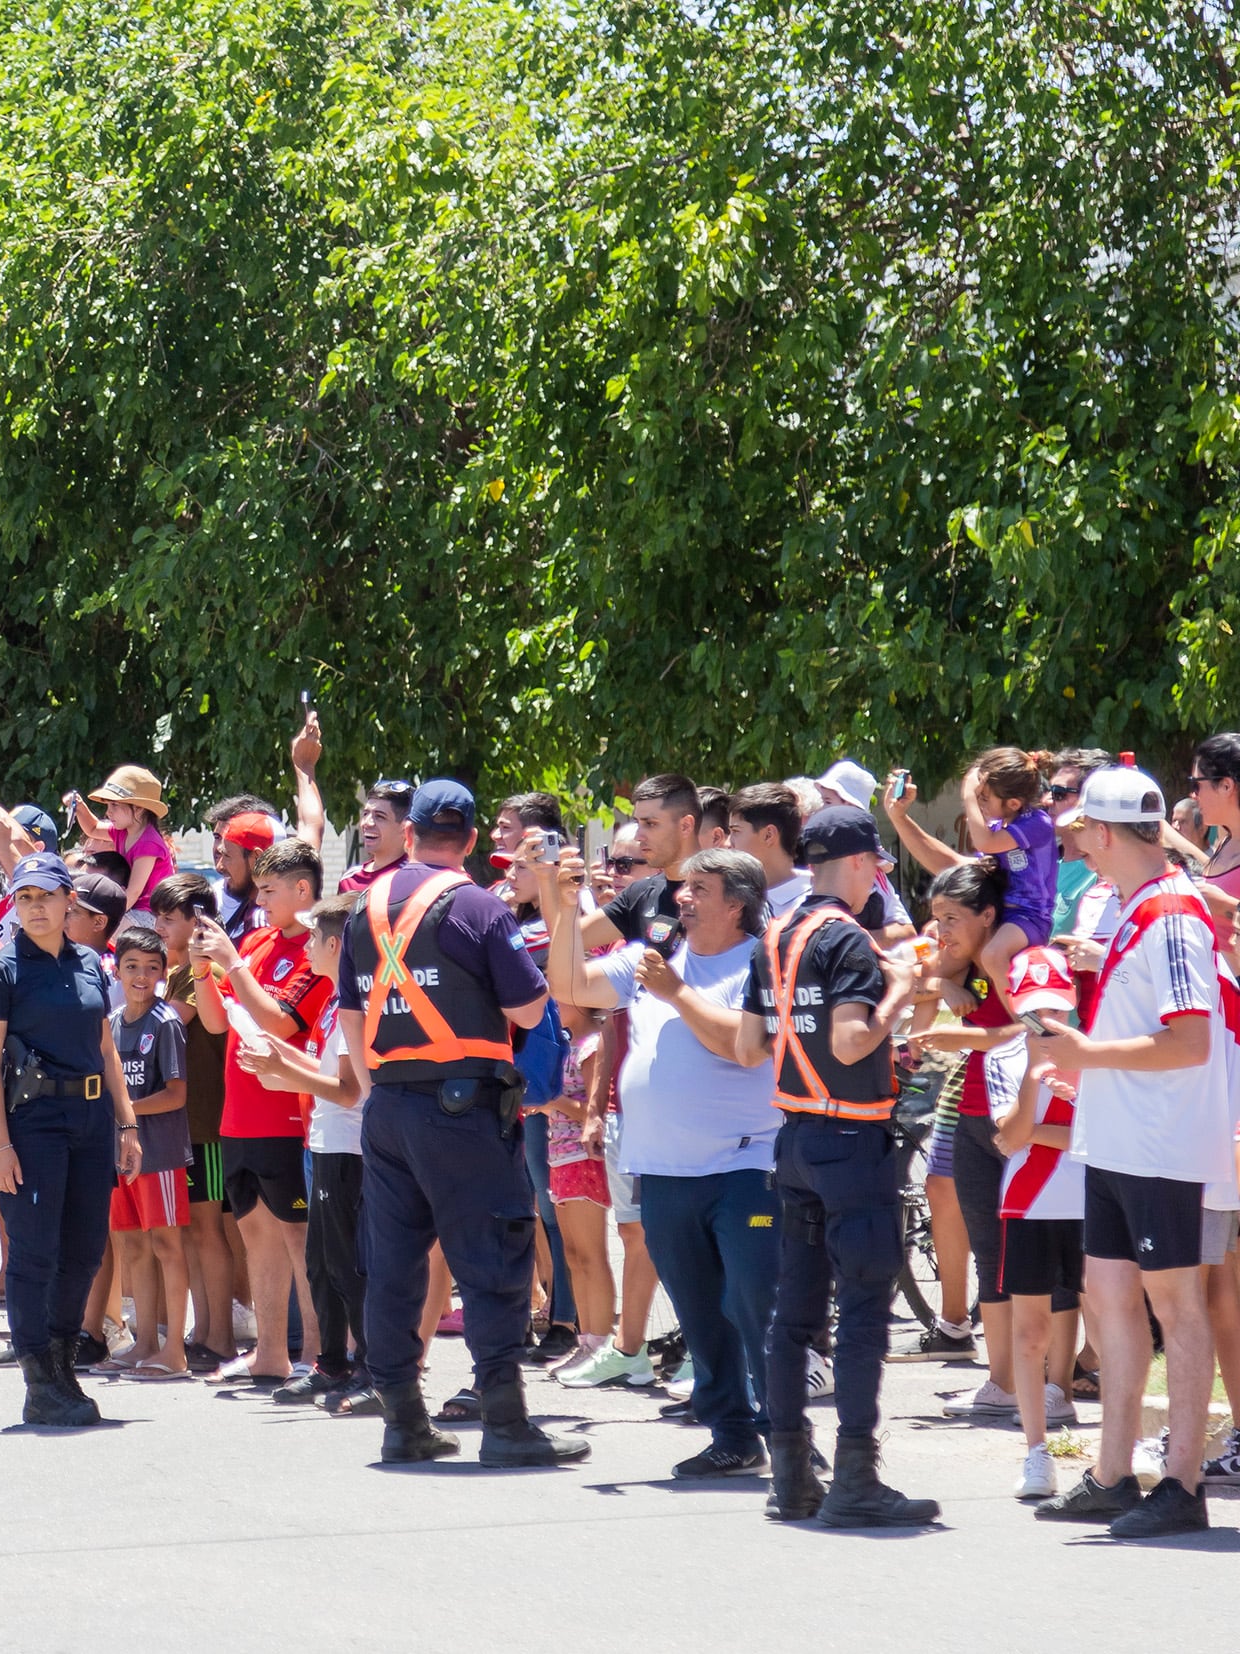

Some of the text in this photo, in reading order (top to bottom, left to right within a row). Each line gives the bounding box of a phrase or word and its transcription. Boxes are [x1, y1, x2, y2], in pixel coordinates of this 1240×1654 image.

[412, 968, 440, 987] DE
[796, 986, 824, 1006] DE
[791, 1014, 817, 1034] UIS
[749, 1215, 774, 1227] NIKE
